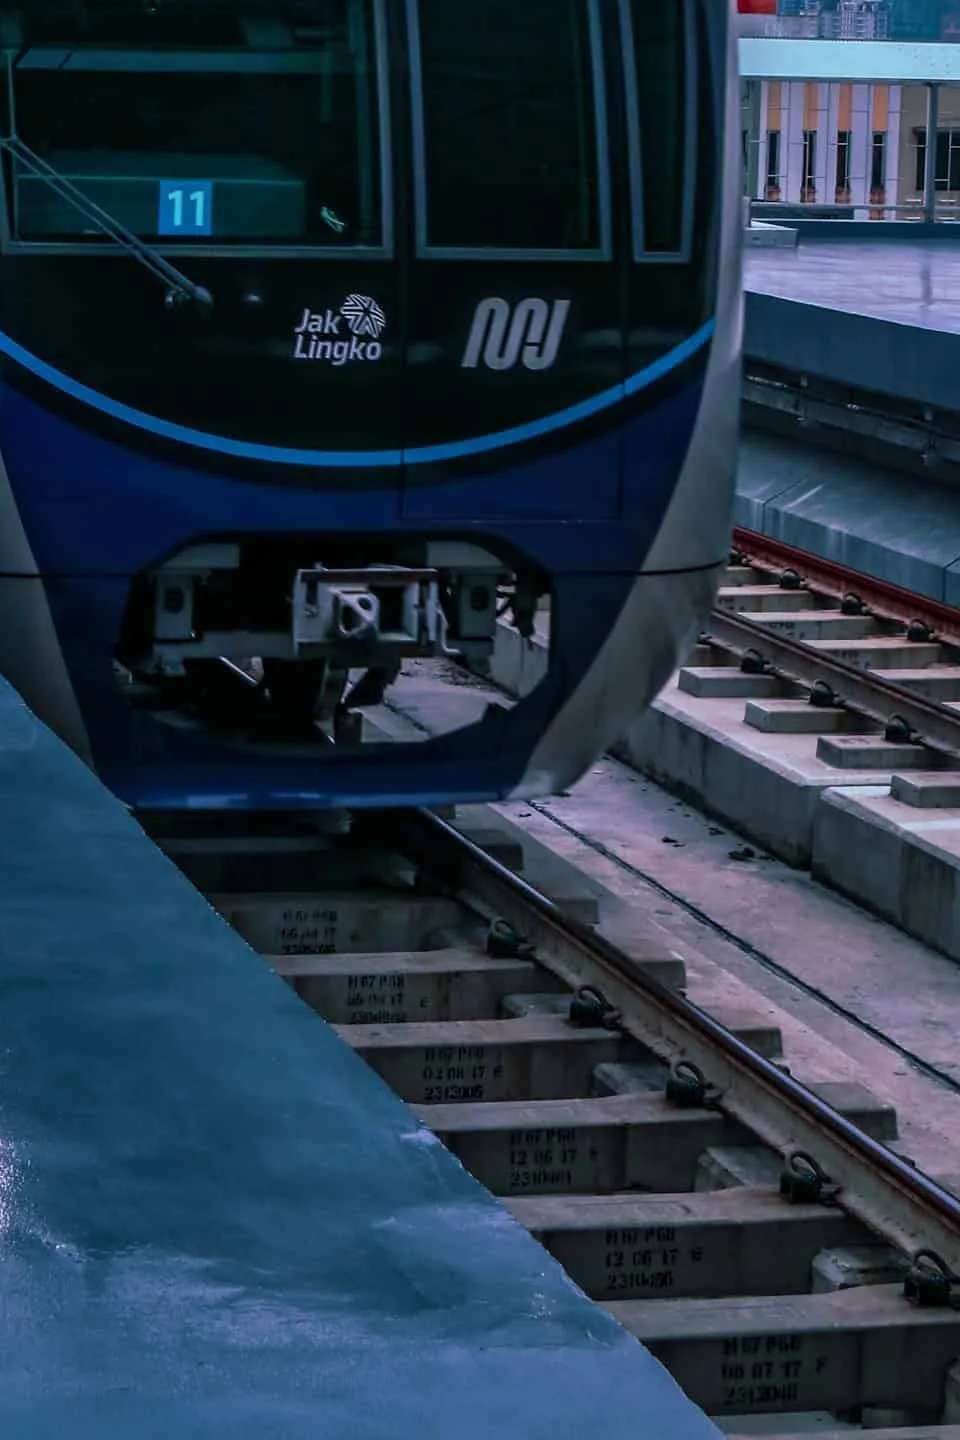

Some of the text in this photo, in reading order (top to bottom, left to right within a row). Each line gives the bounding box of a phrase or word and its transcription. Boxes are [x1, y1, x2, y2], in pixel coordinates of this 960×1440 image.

[167, 190, 206, 227] 11
[294, 308, 339, 335] Jak
[294, 335, 382, 365] Lingko
